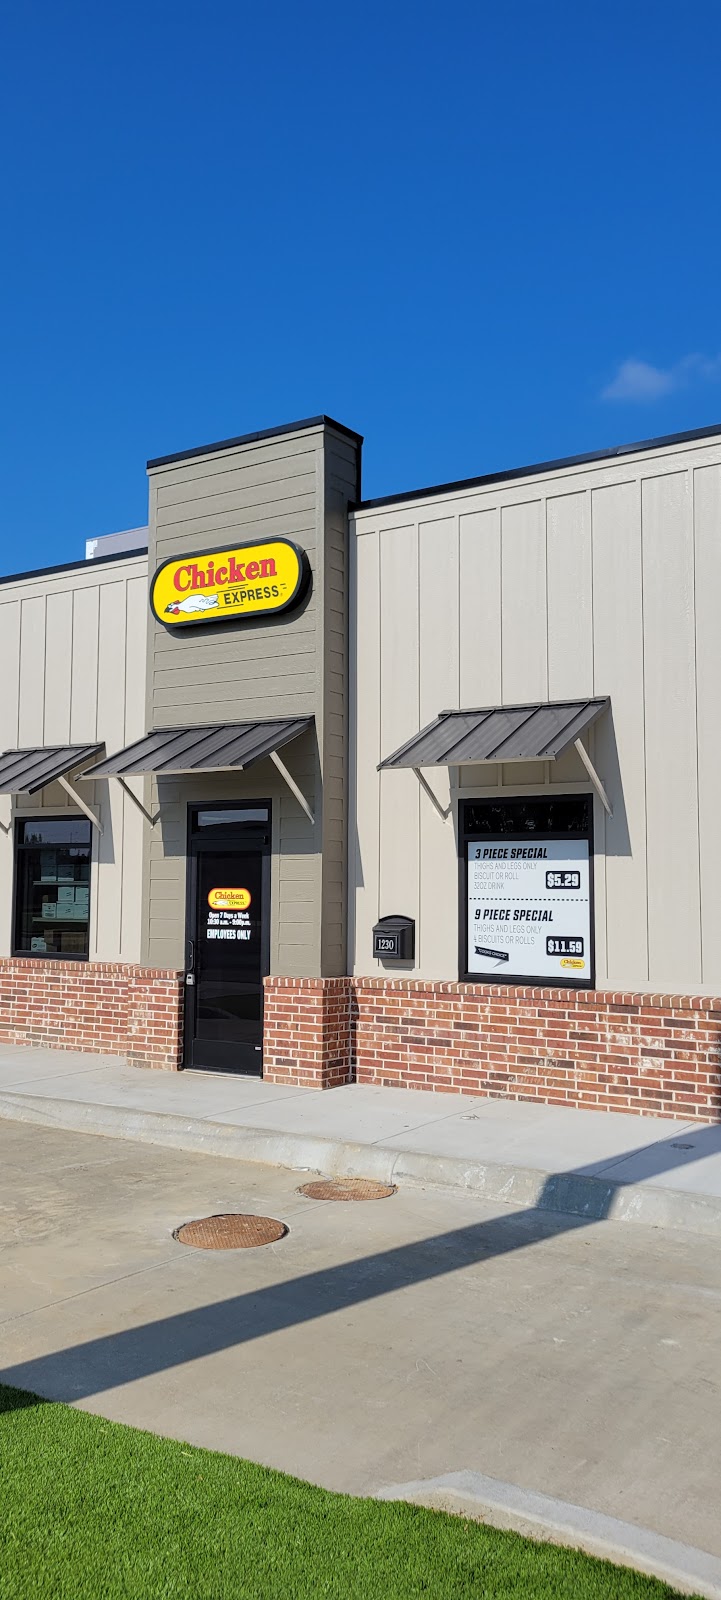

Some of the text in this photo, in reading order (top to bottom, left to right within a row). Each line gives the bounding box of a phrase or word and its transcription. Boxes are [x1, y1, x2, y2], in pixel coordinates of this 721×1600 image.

[173, 557, 277, 592] Chicken
[223, 585, 279, 605] EXPRESS
[475, 847, 548, 859] 3 PIECE SPECIAL
[474, 862, 537, 870] THIGHS AND LEGS ONLY
[474, 872, 519, 880] BISCUIT OR ROLL
[547, 872, 579, 888] $5.29
[488, 882, 505, 890] DRINK
[214, 891, 244, 900] Chicken
[474, 909, 554, 922] 9 PIECE SPECIAL
[207, 929, 251, 940] EMPLOYEES ONLY
[474, 923, 542, 935] THIGHS AND LEGS ONLY
[378, 939, 394, 950] 1230
[477, 935, 504, 944] BISCUITS
[504, 936, 514, 944] OR
[514, 936, 535, 945] ROLLS
[547, 939, 583, 954] $11.59
